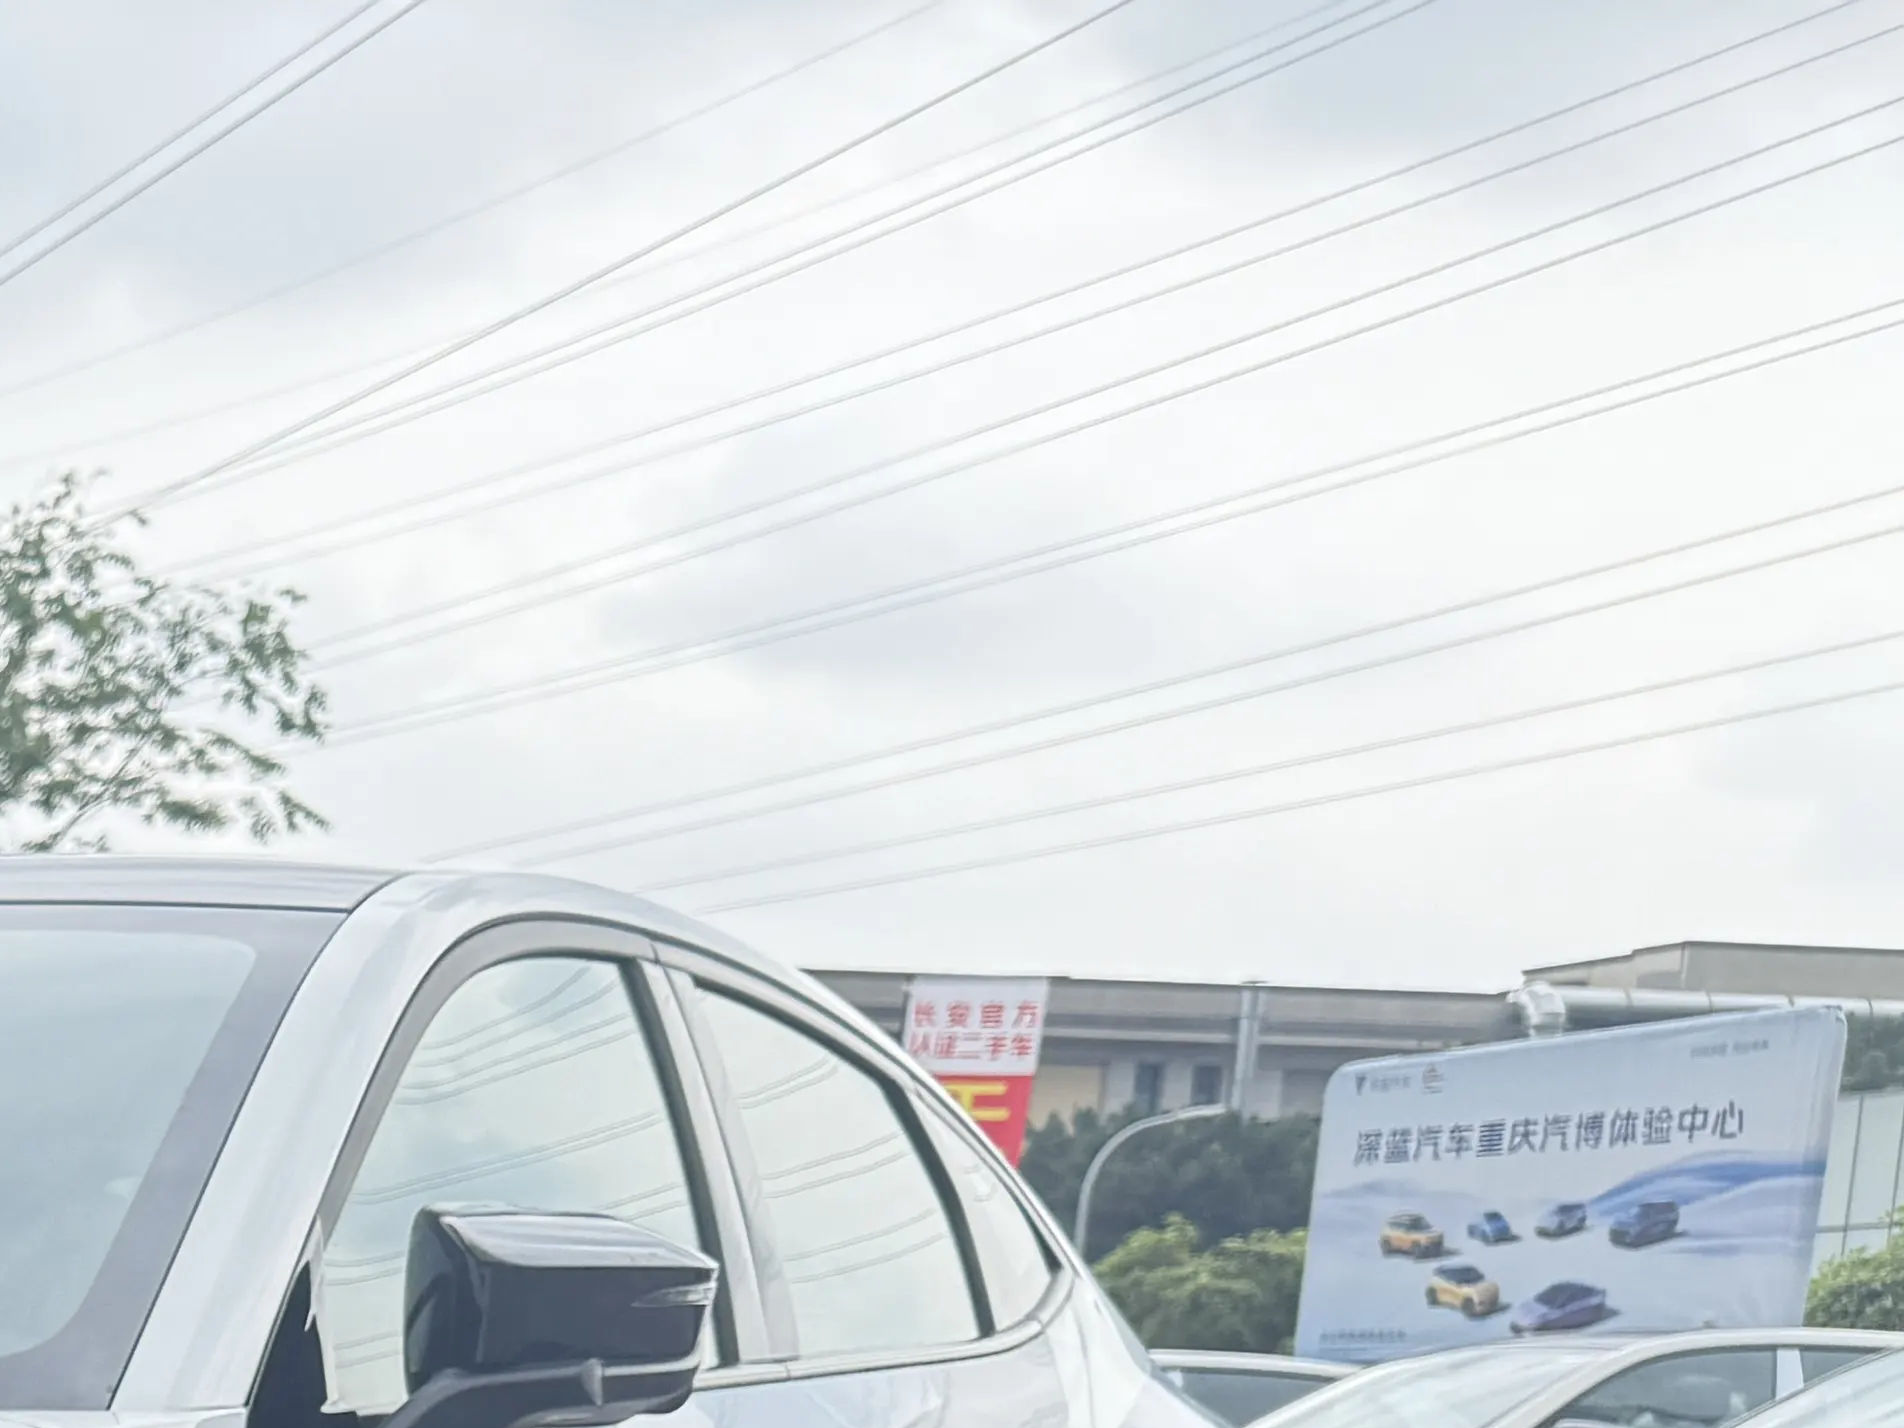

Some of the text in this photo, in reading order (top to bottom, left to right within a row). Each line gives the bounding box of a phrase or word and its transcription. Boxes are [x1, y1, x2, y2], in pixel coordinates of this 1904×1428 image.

[1353, 1099, 1744, 1168] 深蓝汽车重庆汽博体验中心
